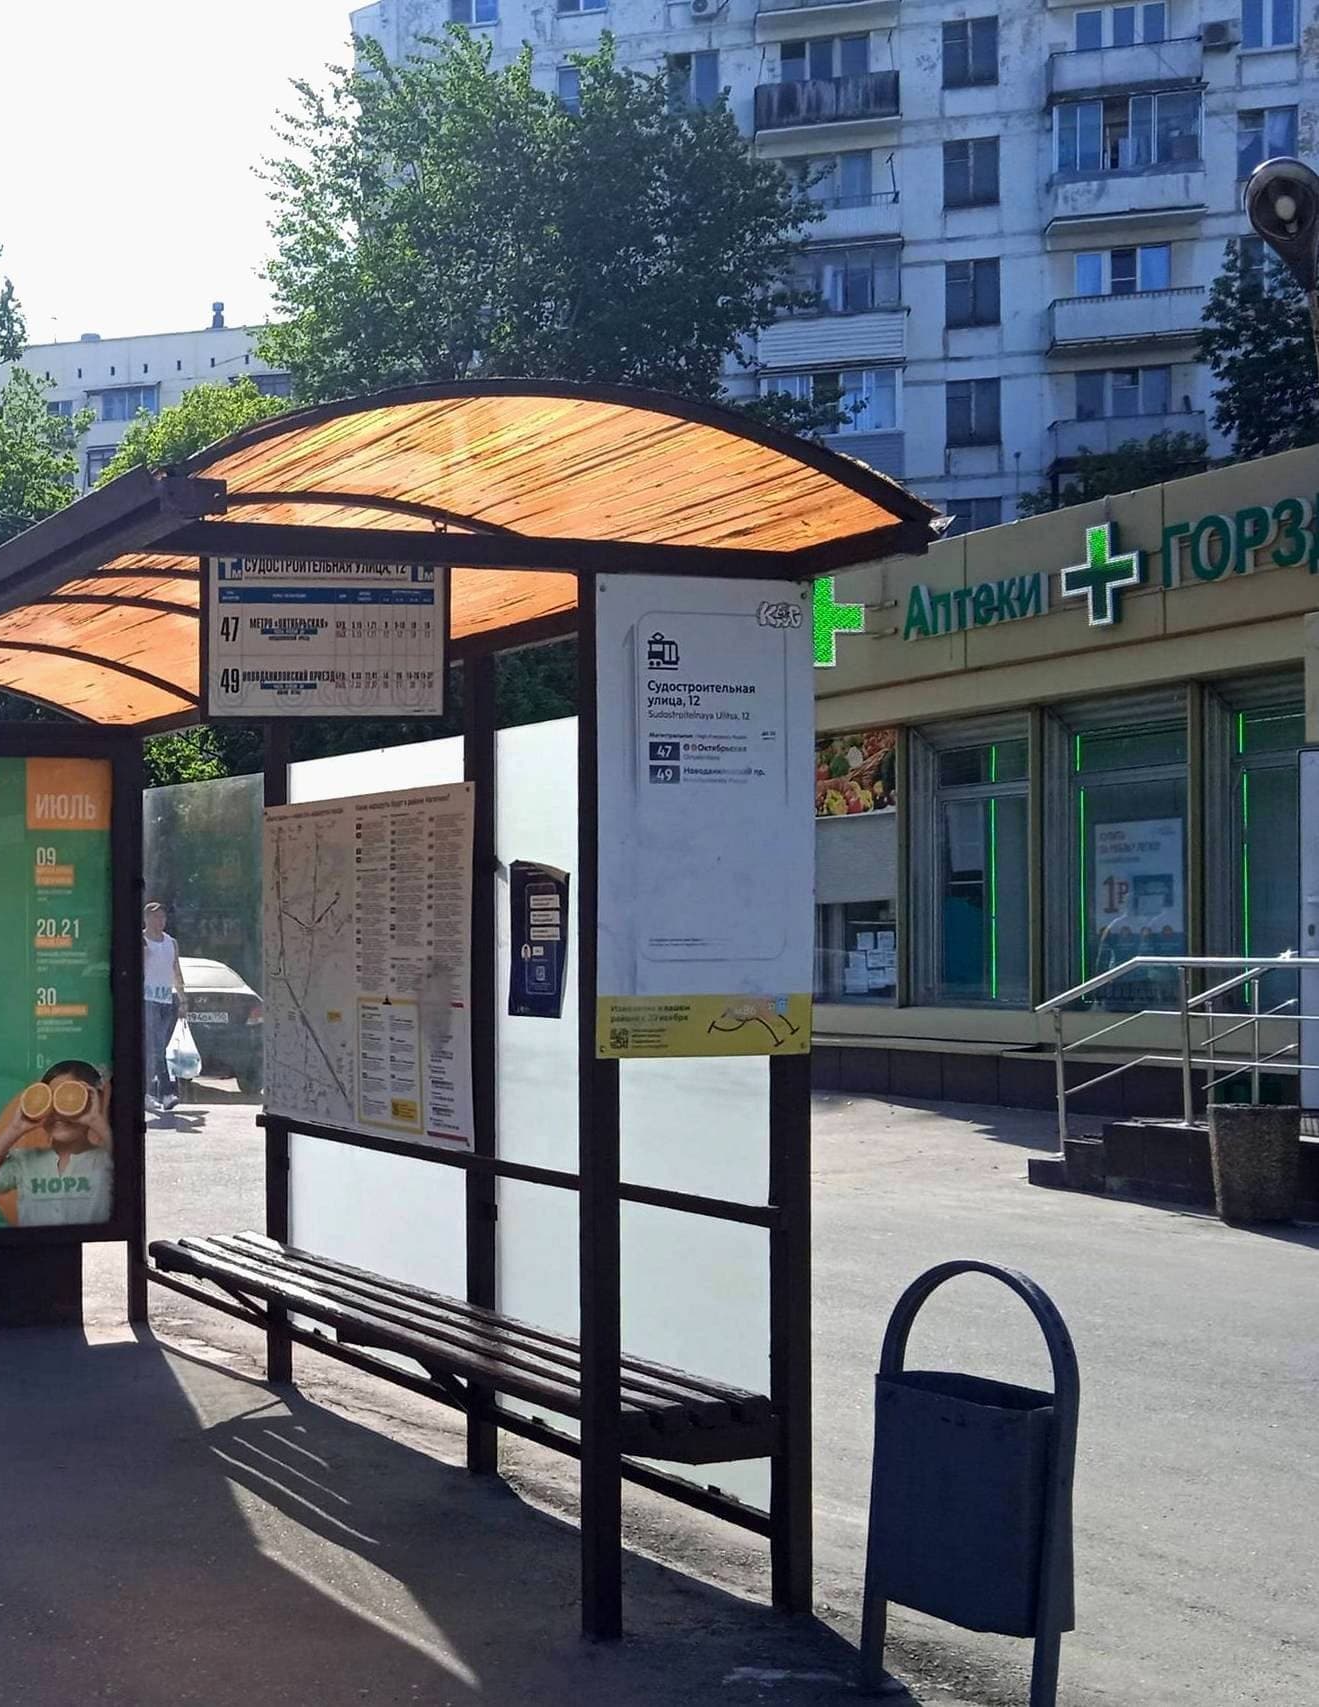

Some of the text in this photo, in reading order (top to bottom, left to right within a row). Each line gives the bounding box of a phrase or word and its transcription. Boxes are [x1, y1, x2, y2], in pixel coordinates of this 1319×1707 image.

[903, 572, 1047, 641] Аптеки
[221, 616, 239, 642] 47
[249, 617, 273, 629] МЕТРО
[221, 668, 240, 694] 49
[647, 680, 756, 694] Судостроительная
[647, 695, 700, 708] улица, 12
[656, 745, 672, 758] 47
[656, 768, 673, 781] 49
[35, 795, 97, 820] ИЮЛЬ
[36, 847, 57, 866] 09
[36, 919, 80, 939] 20.21
[36, 987, 57, 1006] 30
[31, 1176, 91, 1195] НОРА
